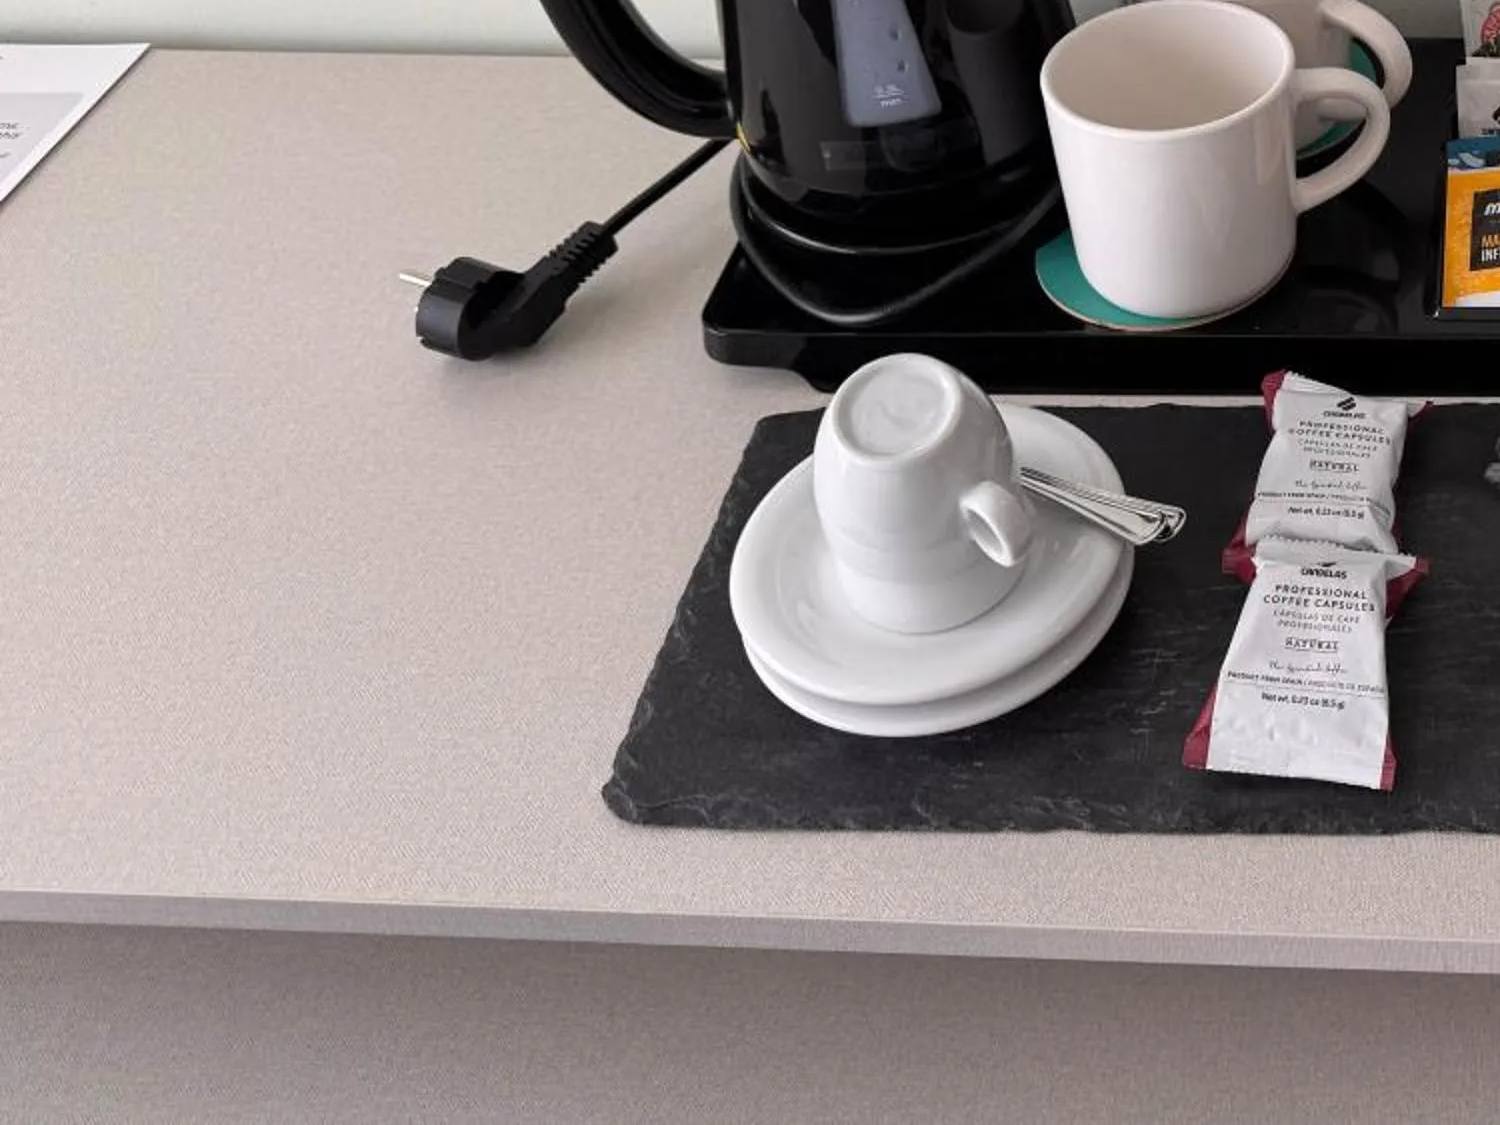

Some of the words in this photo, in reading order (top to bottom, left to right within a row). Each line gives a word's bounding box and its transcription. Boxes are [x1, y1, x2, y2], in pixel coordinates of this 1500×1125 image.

[1299, 420, 1384, 433] PROFESSIONAL
[1288, 428, 1331, 437] COFFEE
[1335, 432, 1390, 445] CAPSULES
[1310, 459, 1360, 472] NATURAL
[1275, 584, 1367, 599] PROFESSIONAL
[1263, 595, 1310, 607] COFFEE
[1314, 599, 1375, 612] CAPSULES
[1285, 637, 1339, 650] NATURAL
[1262, 692, 1276, 702] Net
